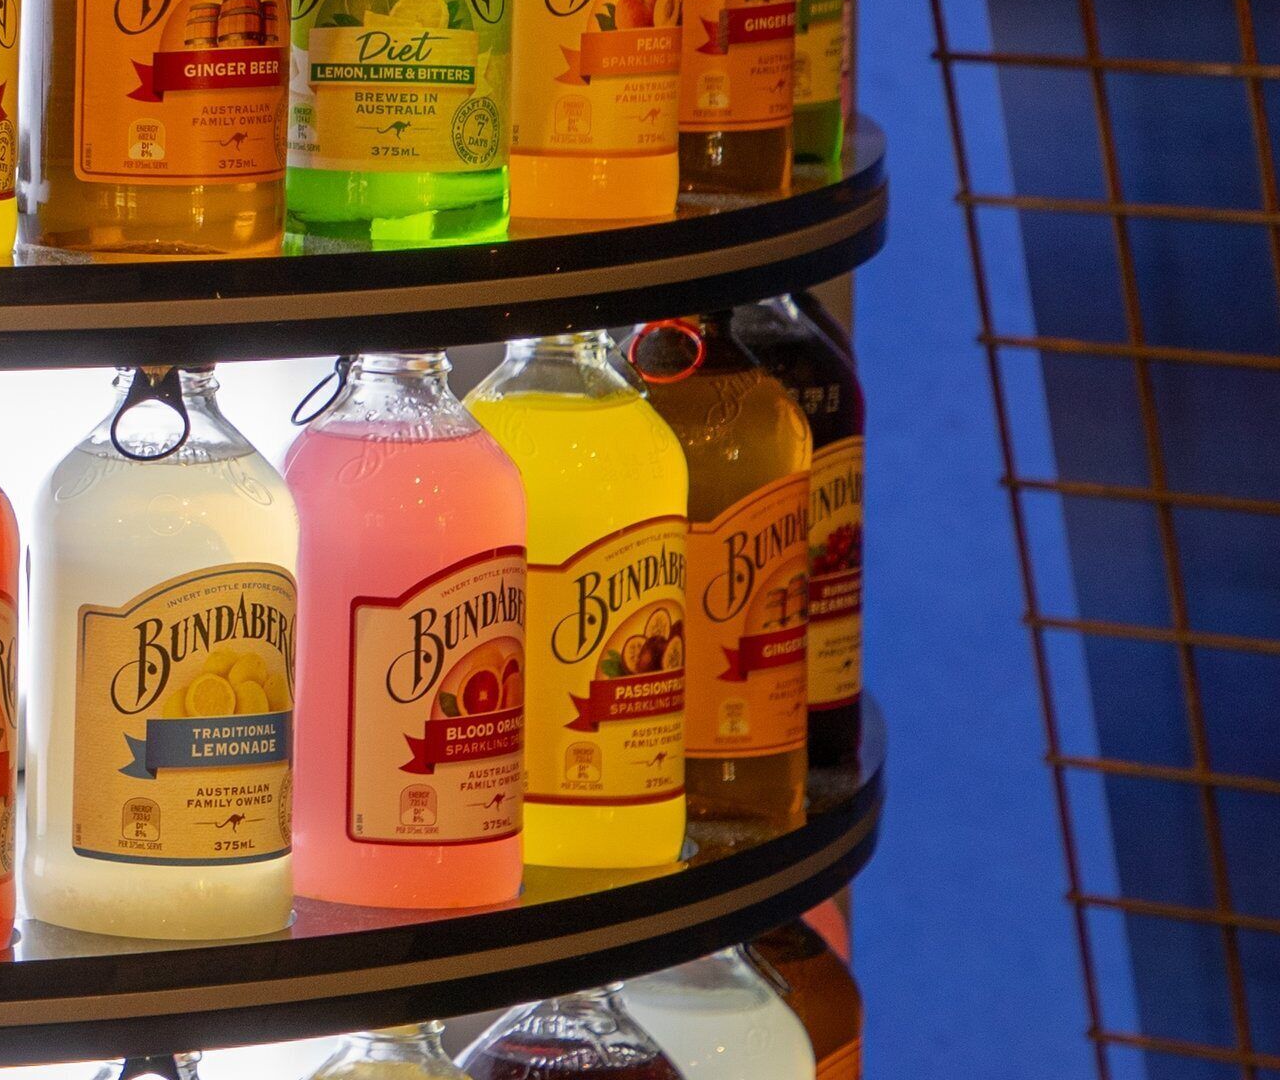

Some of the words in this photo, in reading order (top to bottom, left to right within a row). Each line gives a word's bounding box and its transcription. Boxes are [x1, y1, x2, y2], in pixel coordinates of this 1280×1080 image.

[356, 31, 450, 62] Diet
[637, 37, 672, 51] PEACH
[185, 63, 246, 77] GINGER
[250, 61, 279, 75] BEER
[317, 66, 368, 79] LEMON,
[370, 67, 403, 79] LIME
[406, 69, 415, 79] &
[418, 68, 470, 80] BITTERS
[355, 92, 418, 102] BREWED
[424, 93, 438, 103] IN
[356, 104, 436, 115] AUSTRALIA
[193, 724, 276, 739] TRADITIONAL
[447, 724, 494, 740] BLOOD
[192, 740, 276, 757] LEMONADE
[446, 738, 508, 756] SPARKLING
[197, 784, 270, 796] AUSTRALIAN
[187, 797, 232, 808] FAMILY
[236, 794, 272, 806] OWNED
